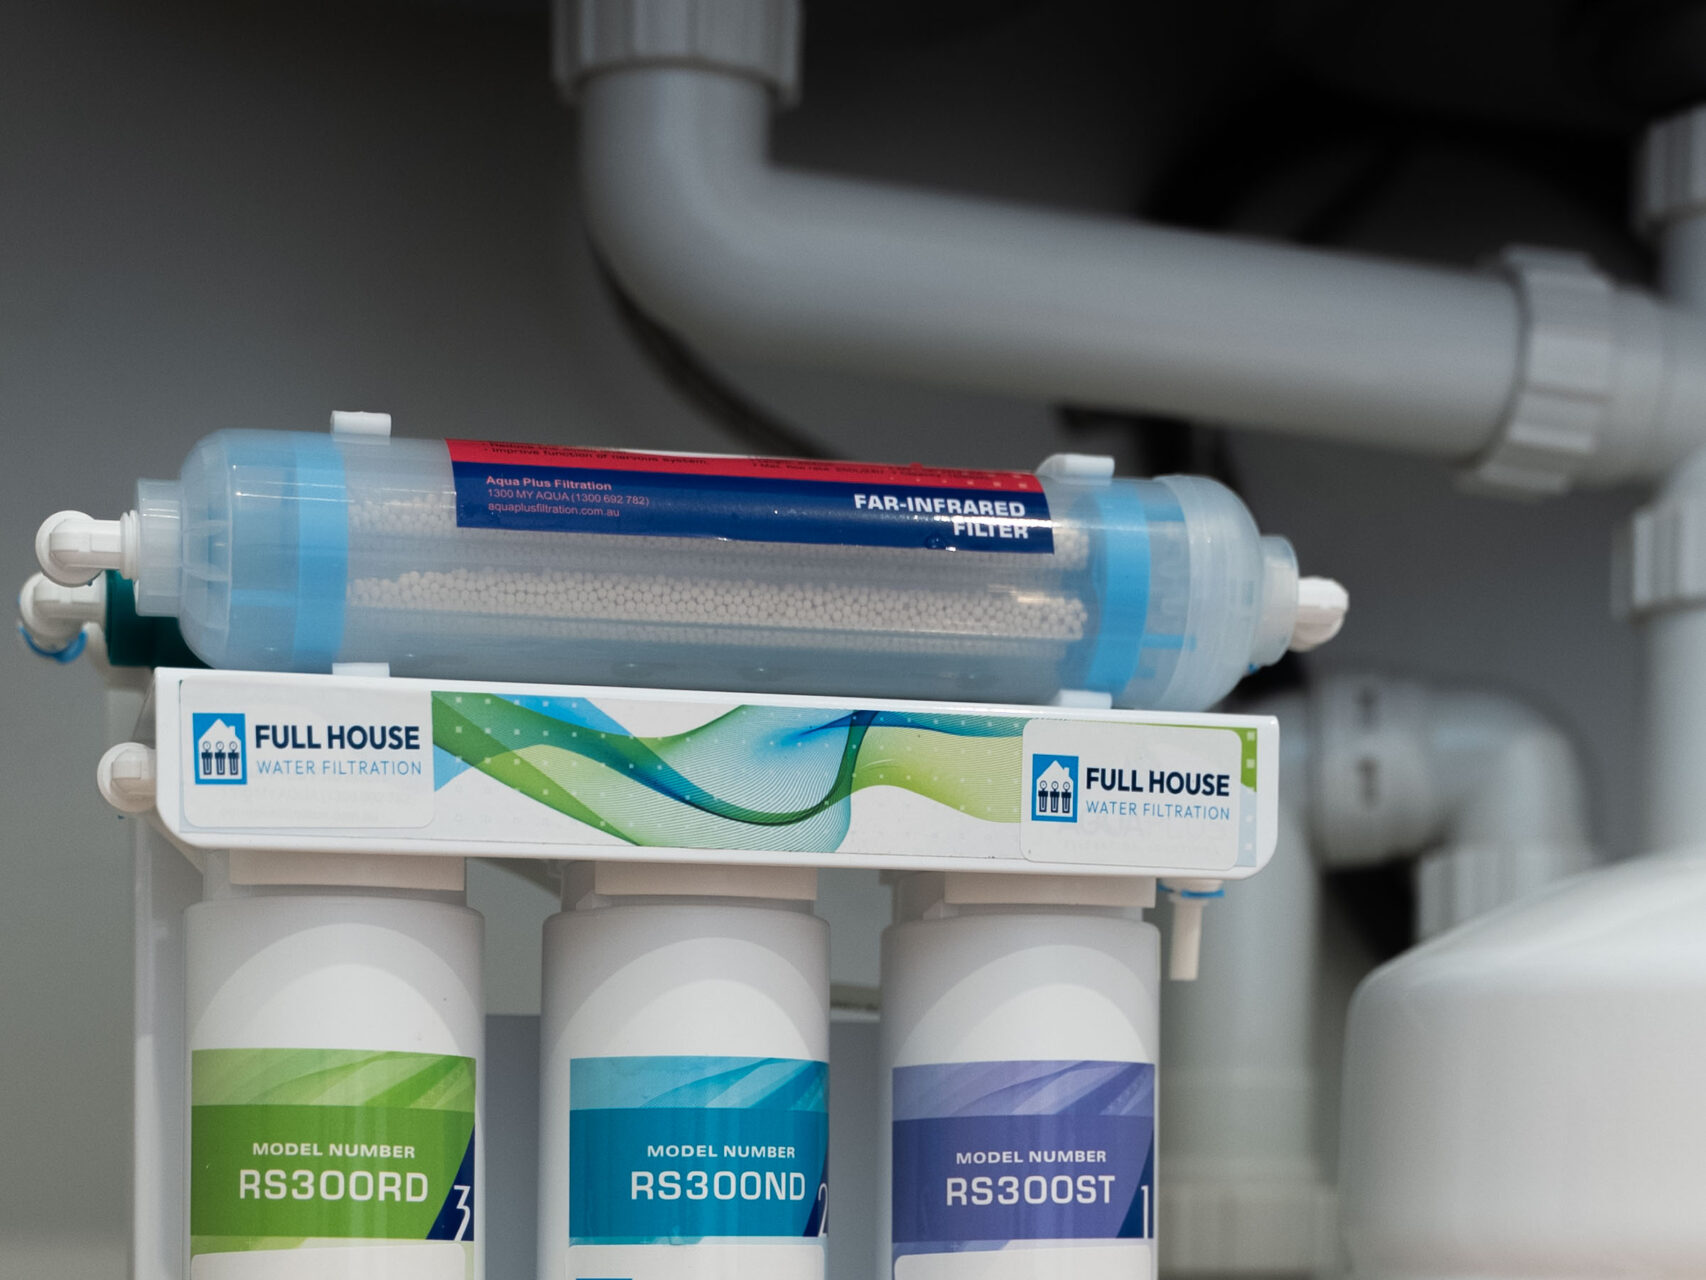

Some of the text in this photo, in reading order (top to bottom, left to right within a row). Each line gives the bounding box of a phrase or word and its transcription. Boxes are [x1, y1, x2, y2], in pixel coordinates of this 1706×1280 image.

[486, 476, 612, 490] Aqua Plus Filtration
[488, 489, 513, 498] 1300
[516, 490, 534, 499] MY
[536, 492, 569, 502] AQUA
[854, 494, 1025, 517] FAR-INFRARED
[953, 521, 1029, 539] FILTER
[255, 725, 420, 750] FULL HOUSE
[257, 760, 422, 776] WATER FILTRATION
[1086, 767, 1230, 797] FULL HOUSE
[1086, 800, 1230, 820] WATER FILTRATION
[253, 1143, 415, 1159] MODEL NUMBER
[648, 1145, 795, 1159] MODEL NUMBER
[956, 1151, 1106, 1164] MODEL NUMBER
[240, 1169, 428, 1202] RS300RD
[631, 1171, 805, 1200] RS300ND
[946, 1175, 1115, 1206] RS300ST
